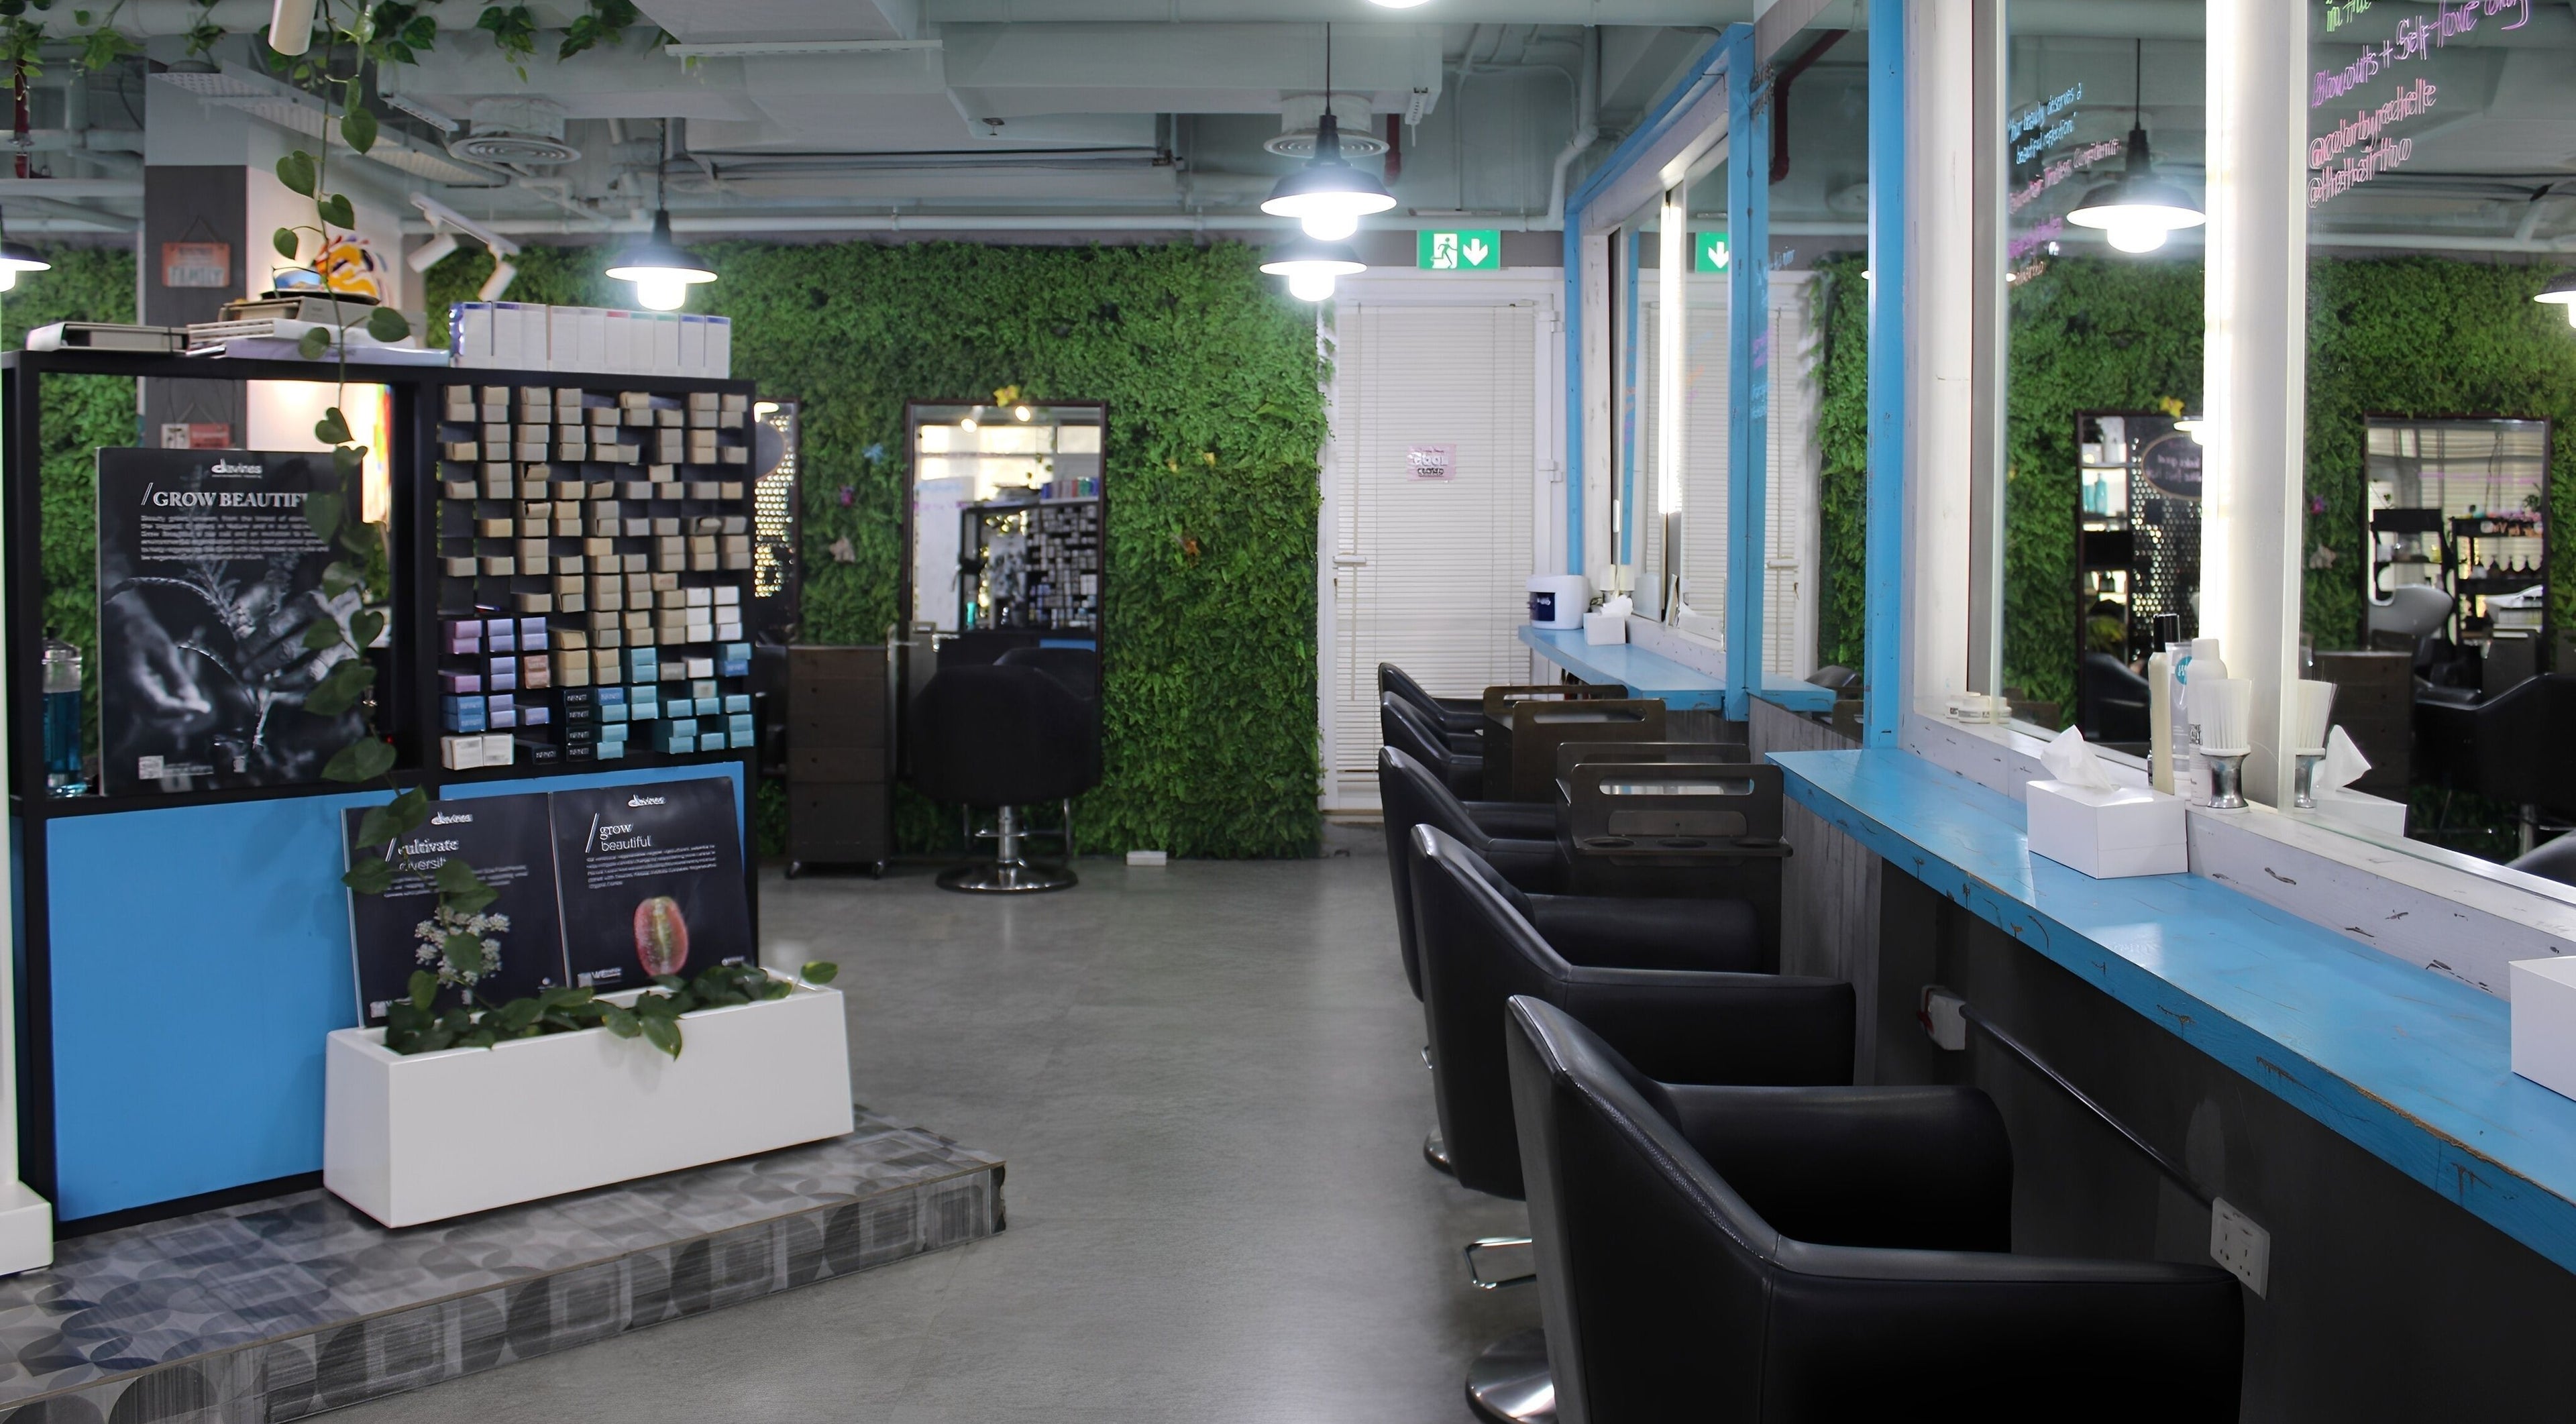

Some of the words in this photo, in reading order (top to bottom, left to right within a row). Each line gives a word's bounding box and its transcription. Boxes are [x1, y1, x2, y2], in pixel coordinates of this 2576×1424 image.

[219, 492, 309, 508] BEAUTIF
[599, 822, 634, 840] grow
[600, 835, 653, 852] beautiful
